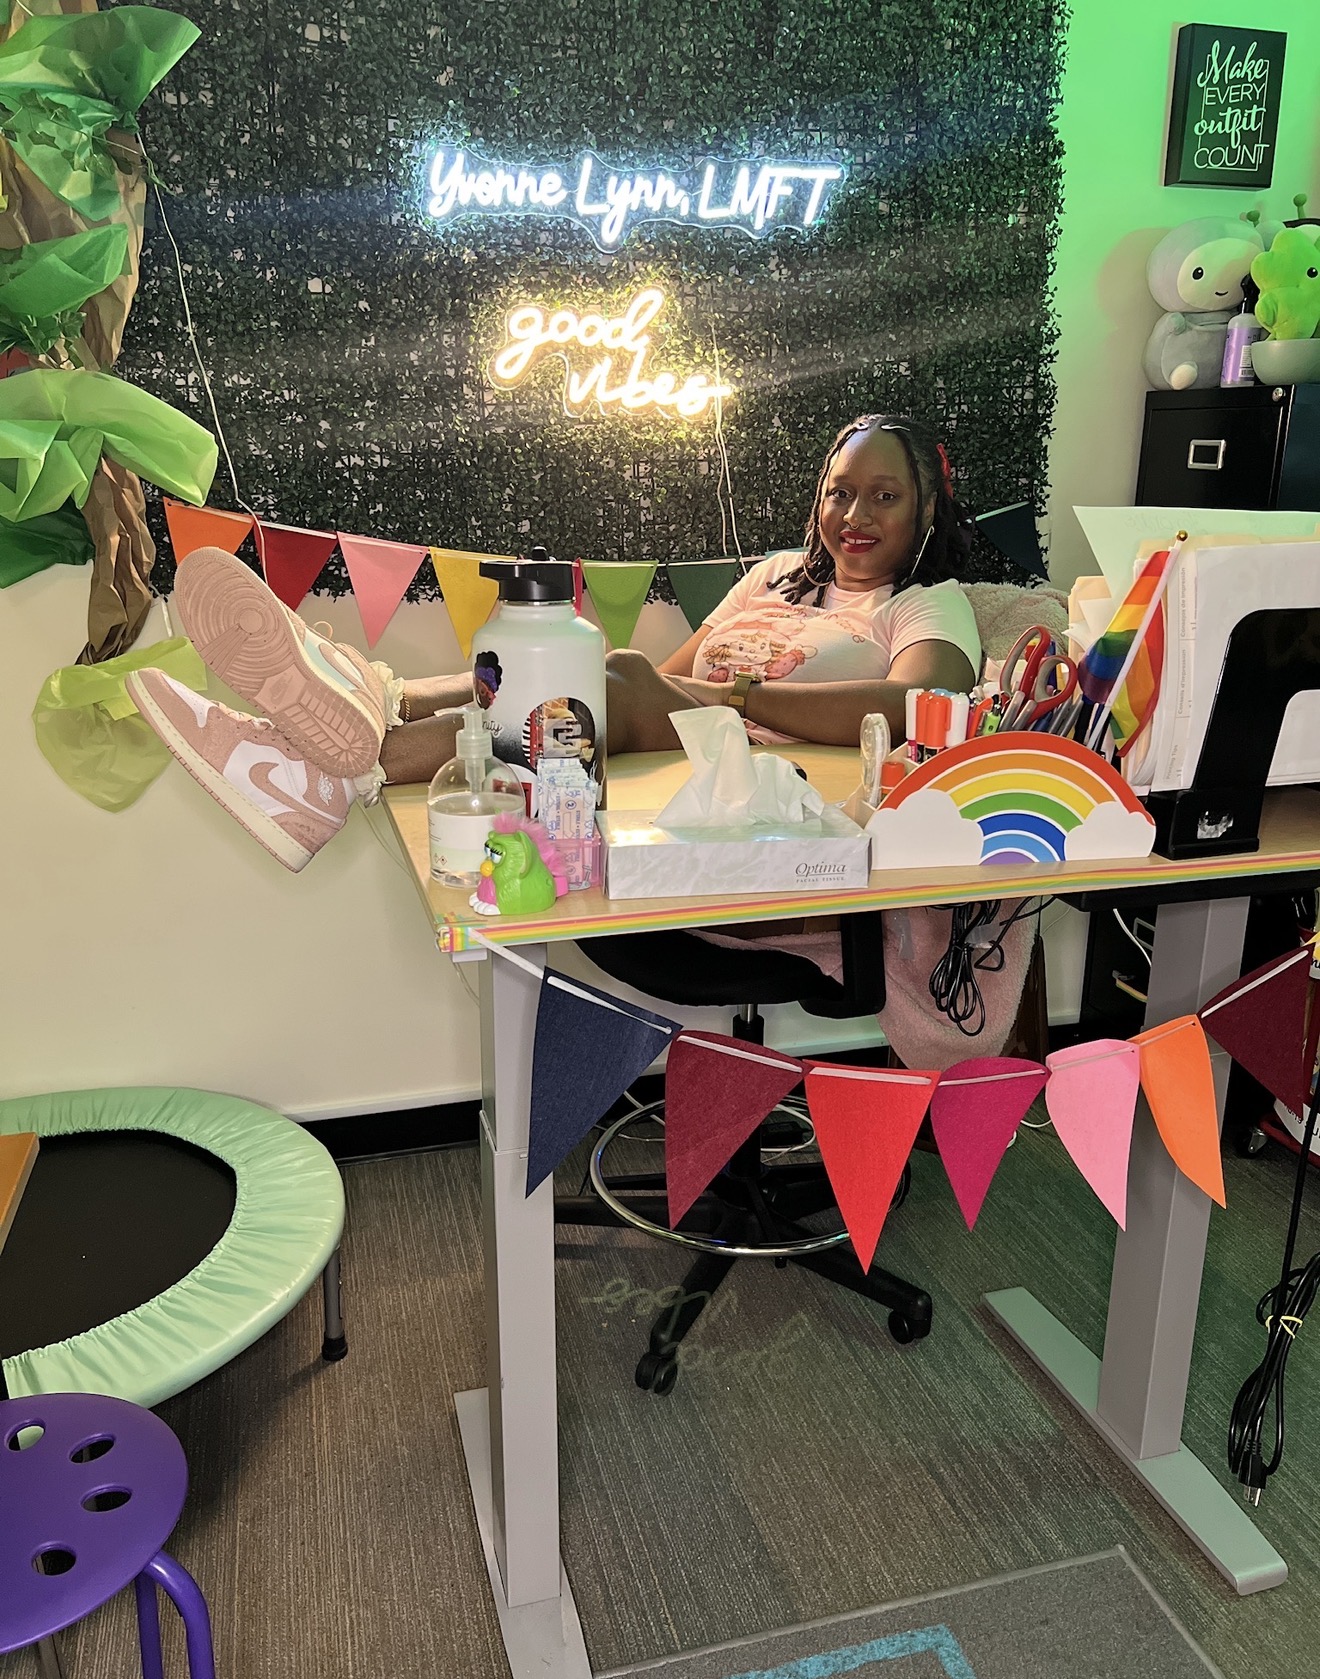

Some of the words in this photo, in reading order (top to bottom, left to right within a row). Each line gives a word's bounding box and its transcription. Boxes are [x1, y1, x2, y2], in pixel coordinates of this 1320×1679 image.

[1197, 40, 1268, 87] Make
[1205, 83, 1266, 106] EVERY
[1194, 104, 1267, 149] outfit
[1194, 144, 1270, 168] COUNT
[430, 151, 567, 218] Yvonne
[698, 164, 842, 230] LMFT
[495, 287, 665, 380] good
[568, 349, 732, 415] vibes
[795, 861, 847, 878] Optima
